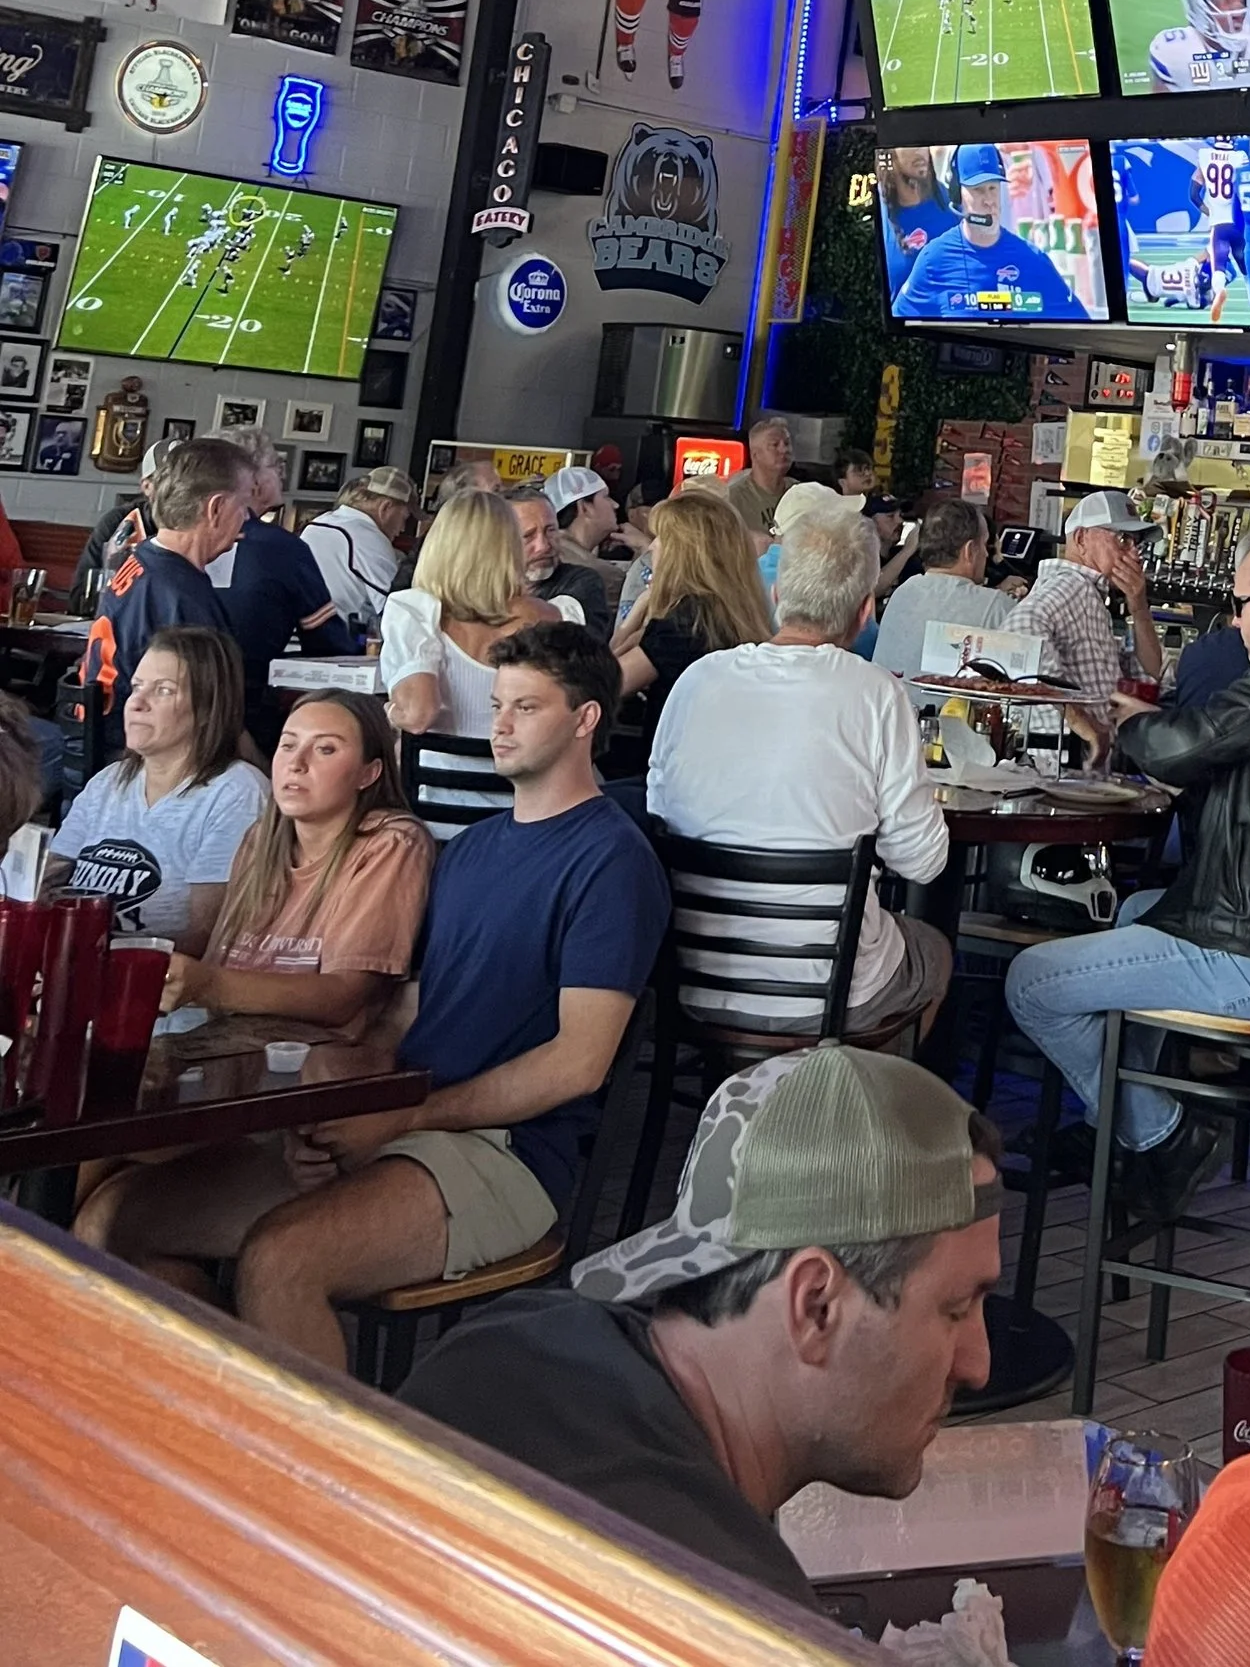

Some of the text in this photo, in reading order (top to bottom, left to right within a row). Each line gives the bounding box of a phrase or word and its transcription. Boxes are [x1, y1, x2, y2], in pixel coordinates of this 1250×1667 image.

[371, 10, 449, 36] CHAMPIONS
[288, 30, 327, 45] GOAL
[1216, 63, 1225, 75] 3
[1206, 163, 1234, 200] 98
[475, 211, 526, 227] EATERY
[592, 214, 731, 258] CAMBRIDGE
[594, 237, 721, 287] BEARS
[509, 282, 561, 303] Corona
[1160, 269, 1183, 293] 31
[522, 300, 552, 314] Extra
[964, 294, 977, 306] 10
[1015, 294, 1023, 305] 0
[508, 454, 547, 476] GRACE
[1188, 515, 1200, 553] TRULY
[69, 860, 151, 896] SUNDAY
